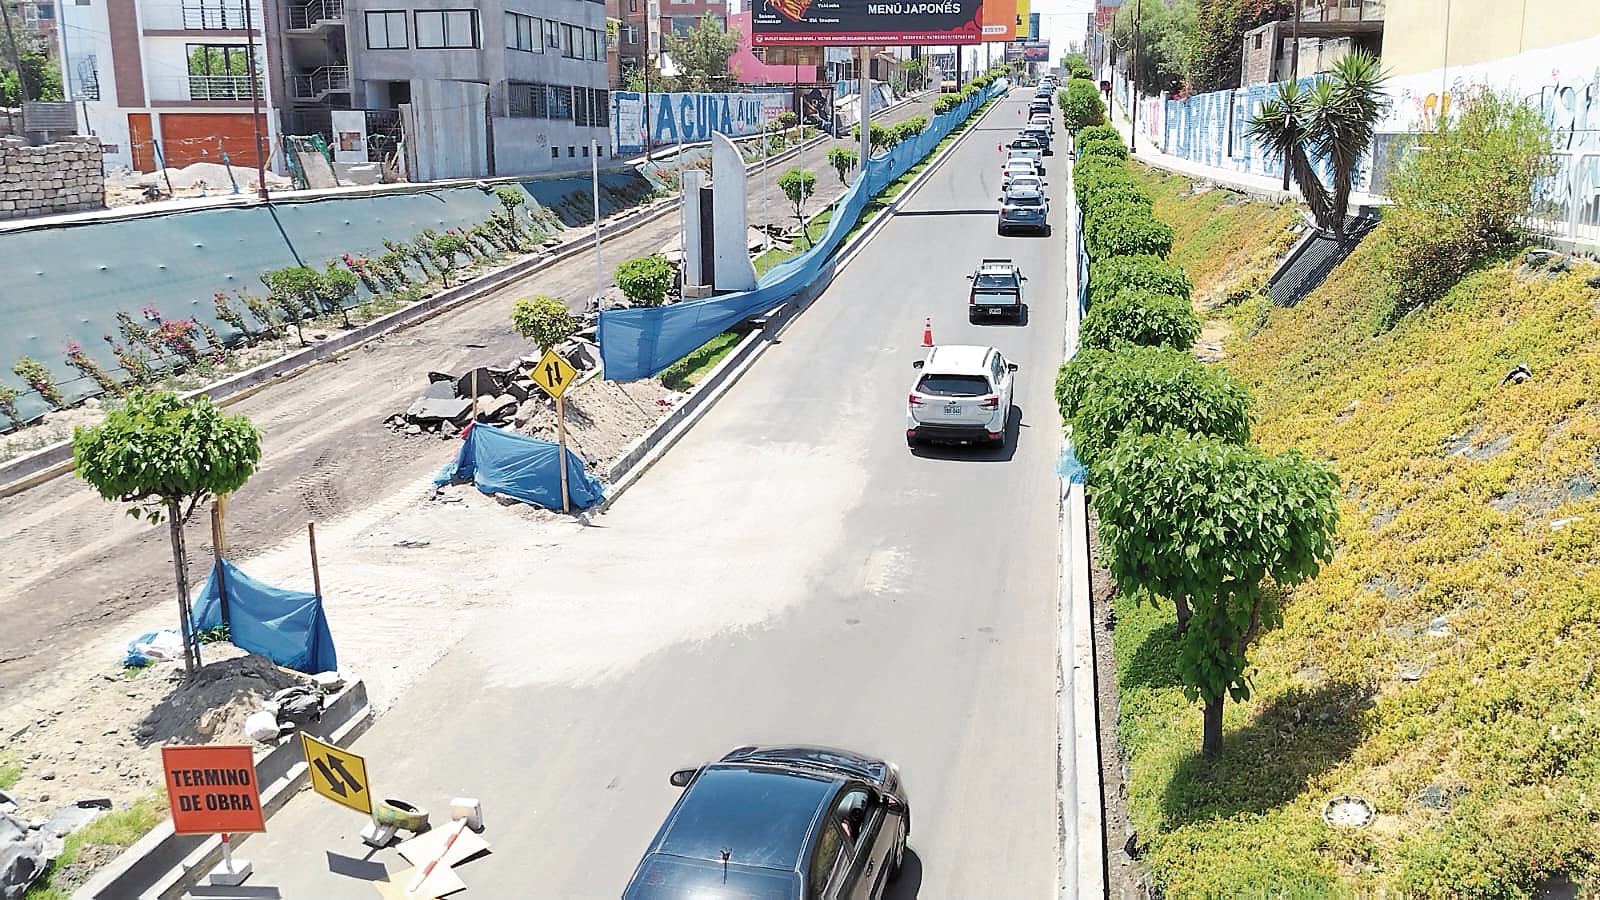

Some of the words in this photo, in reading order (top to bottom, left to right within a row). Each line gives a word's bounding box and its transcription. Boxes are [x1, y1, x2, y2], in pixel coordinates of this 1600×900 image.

[868, 2, 902, 14] MENÚ
[903, 1, 961, 14] JAPONÉS
[171, 768, 249, 787] TERMINO
[178, 795, 202, 812] DE
[205, 792, 254, 811] OBRA
